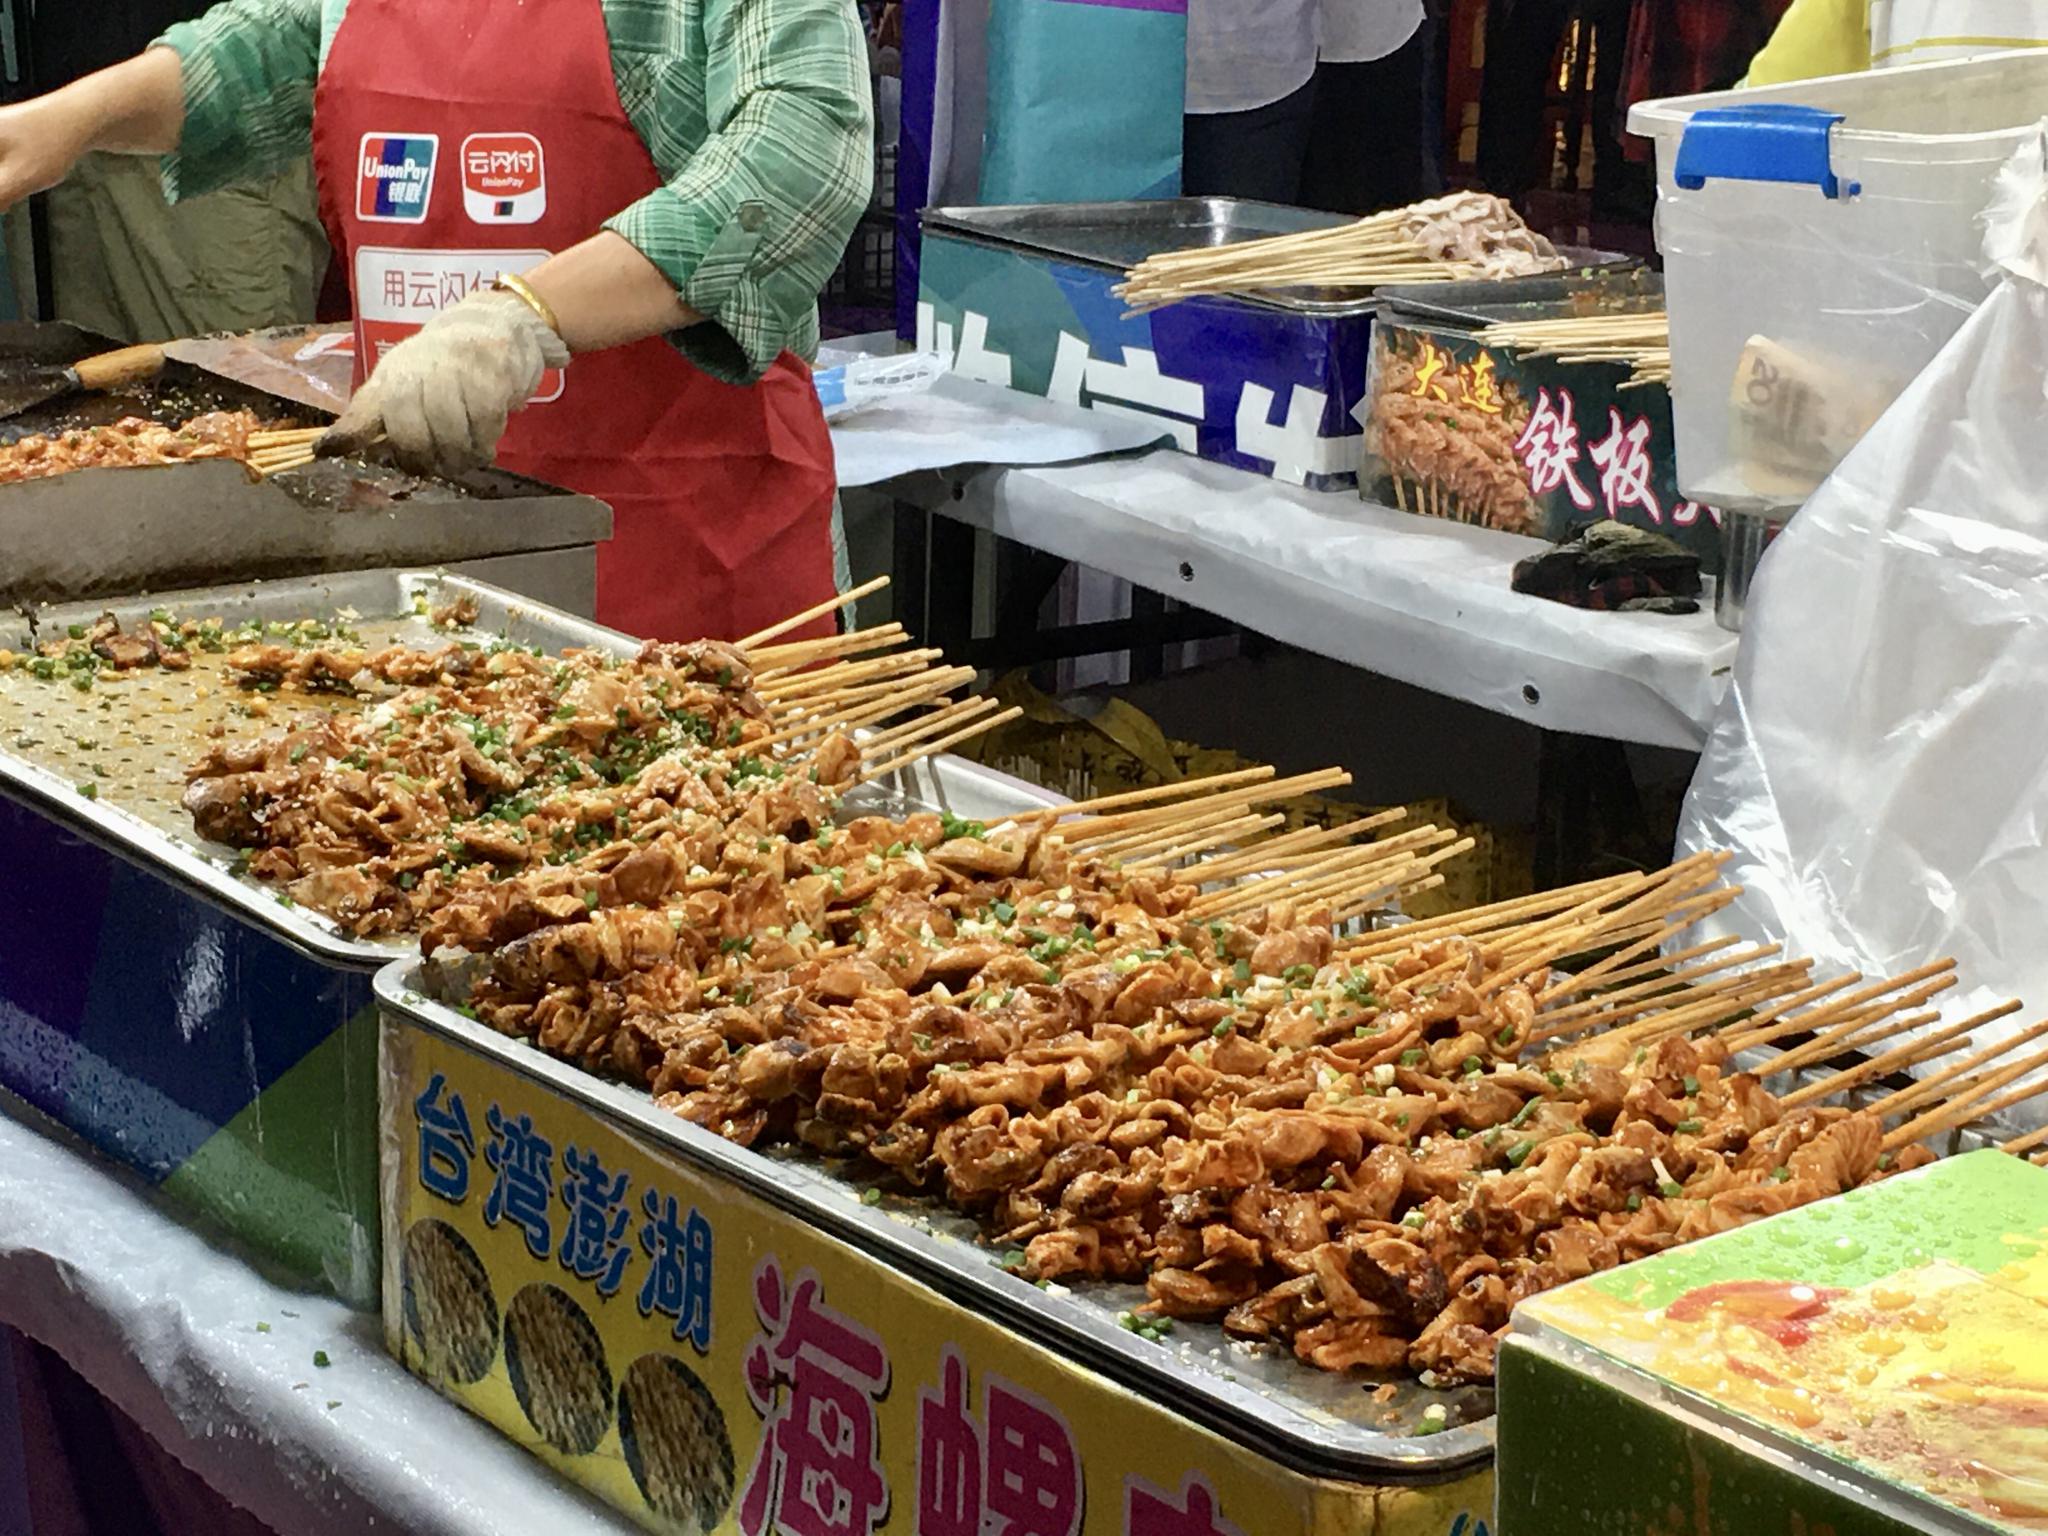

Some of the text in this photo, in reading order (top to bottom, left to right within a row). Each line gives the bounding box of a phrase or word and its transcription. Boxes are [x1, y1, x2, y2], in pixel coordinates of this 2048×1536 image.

[364, 156, 429, 187] UnionPay
[468, 149, 536, 174] 云闪付
[1410, 342, 1502, 415] 大连
[1514, 386, 1722, 528] 铁板
[414, 1072, 716, 1354] 台湾澎湖
[739, 1252, 1252, 1536] 海螺
